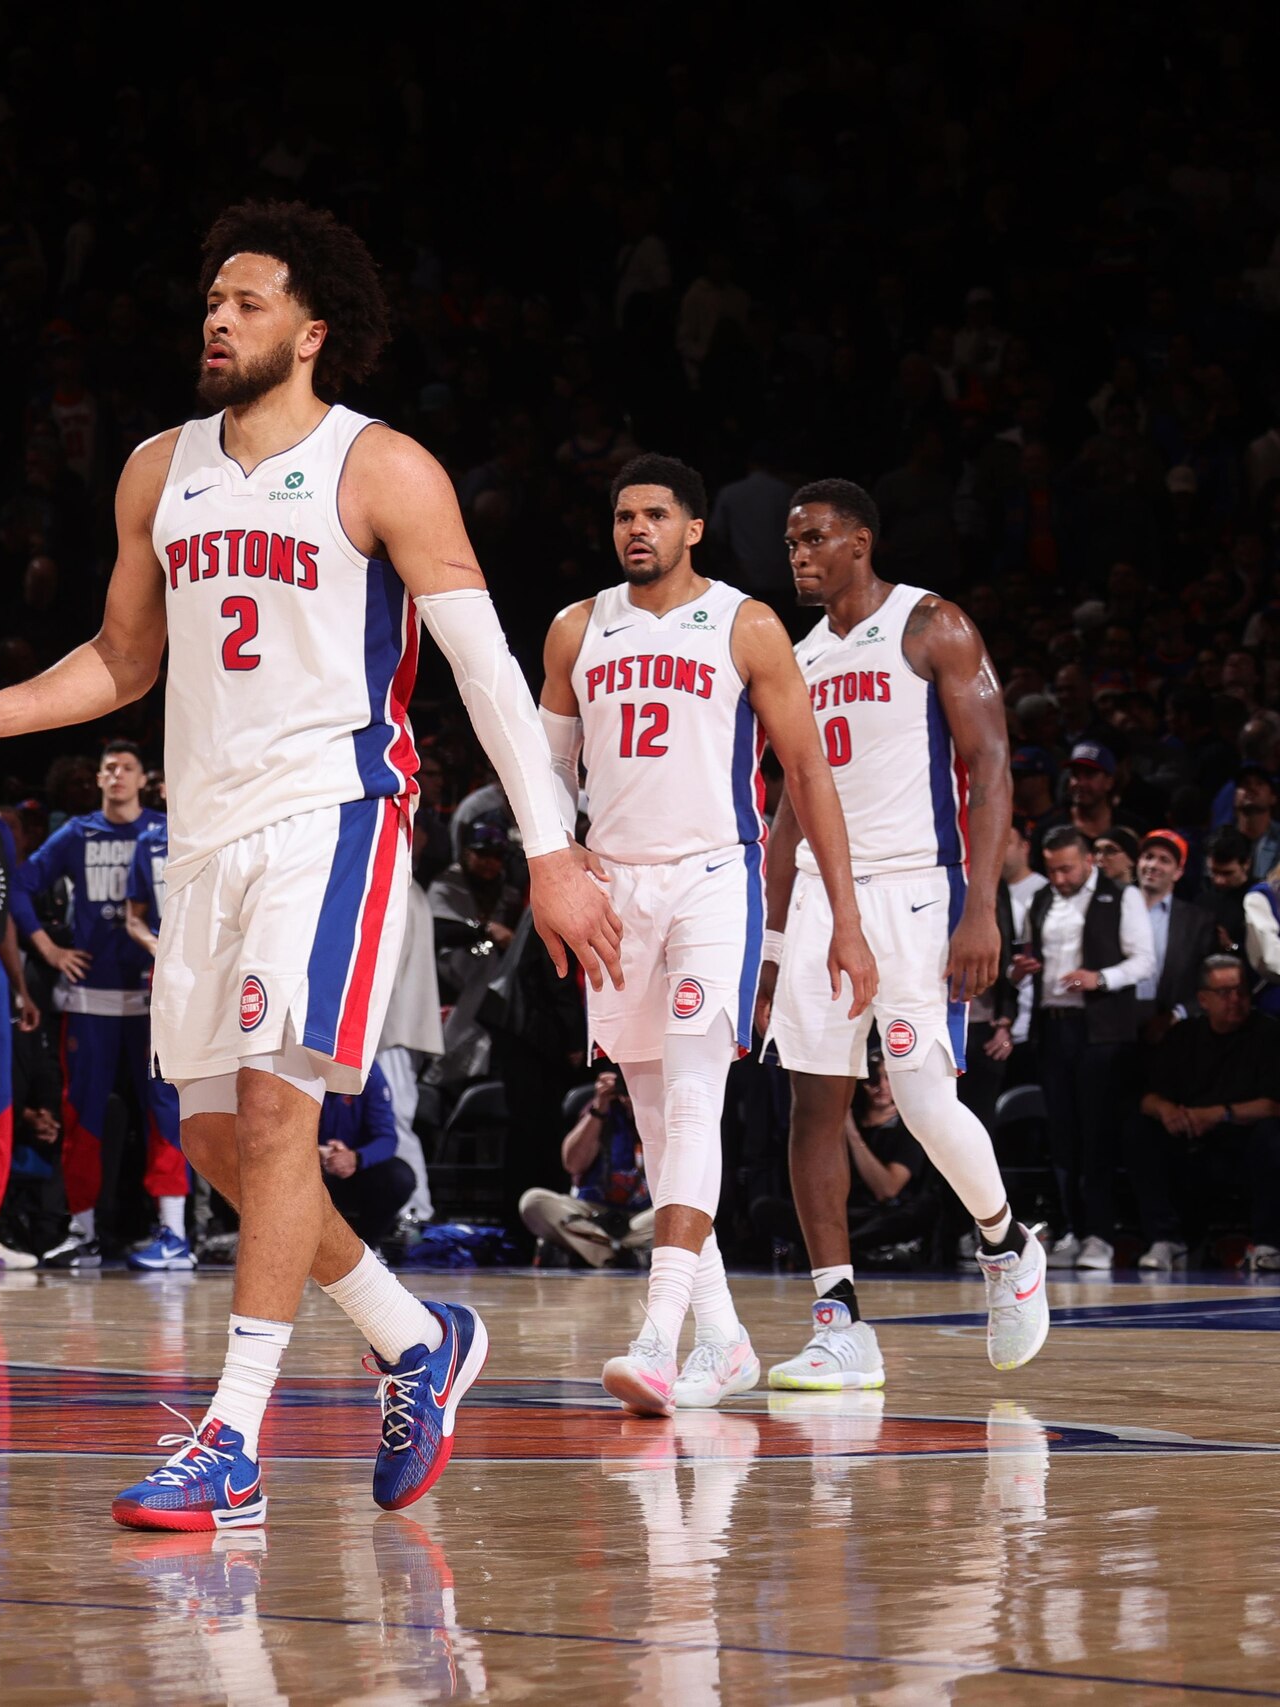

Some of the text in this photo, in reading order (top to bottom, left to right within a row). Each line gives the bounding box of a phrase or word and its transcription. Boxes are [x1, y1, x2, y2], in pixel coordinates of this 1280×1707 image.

[268, 490, 314, 501] StockX
[165, 529, 319, 590] PISTONS
[221, 596, 261, 671] 2
[585, 654, 716, 703] PISTONS
[809, 671, 891, 711] ISTONS
[619, 702, 669, 758] 12
[824, 716, 852, 767] 0
